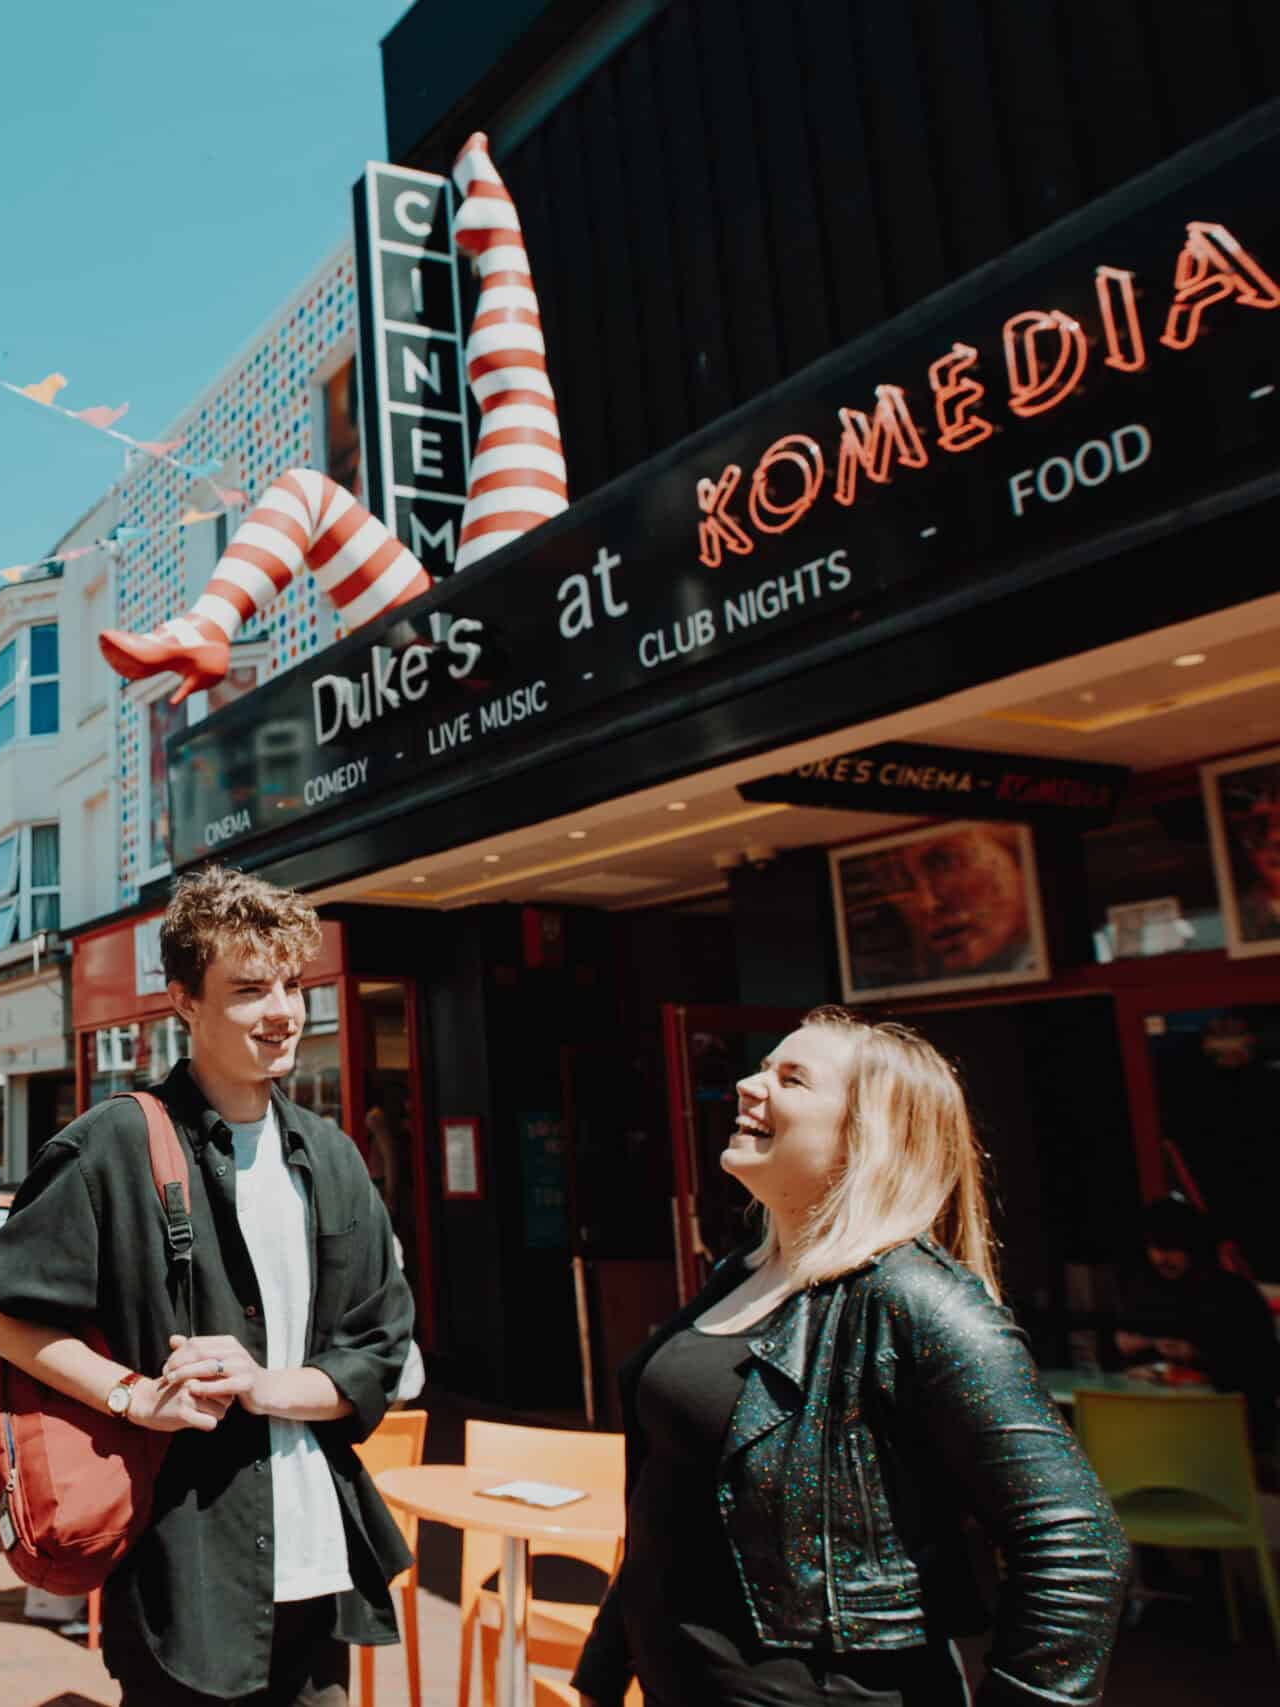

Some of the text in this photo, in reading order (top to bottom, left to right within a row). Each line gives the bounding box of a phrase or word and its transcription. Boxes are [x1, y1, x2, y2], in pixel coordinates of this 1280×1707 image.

[311, 220, 1280, 746] Duke's at KOMEDIA
[393, 191, 455, 580] CINEM
[204, 423, 1152, 847] CINEMA COMEDY LIVE MUSIC CLUB NIGHTS FOOD
[879, 761, 974, 793] CINEMA
